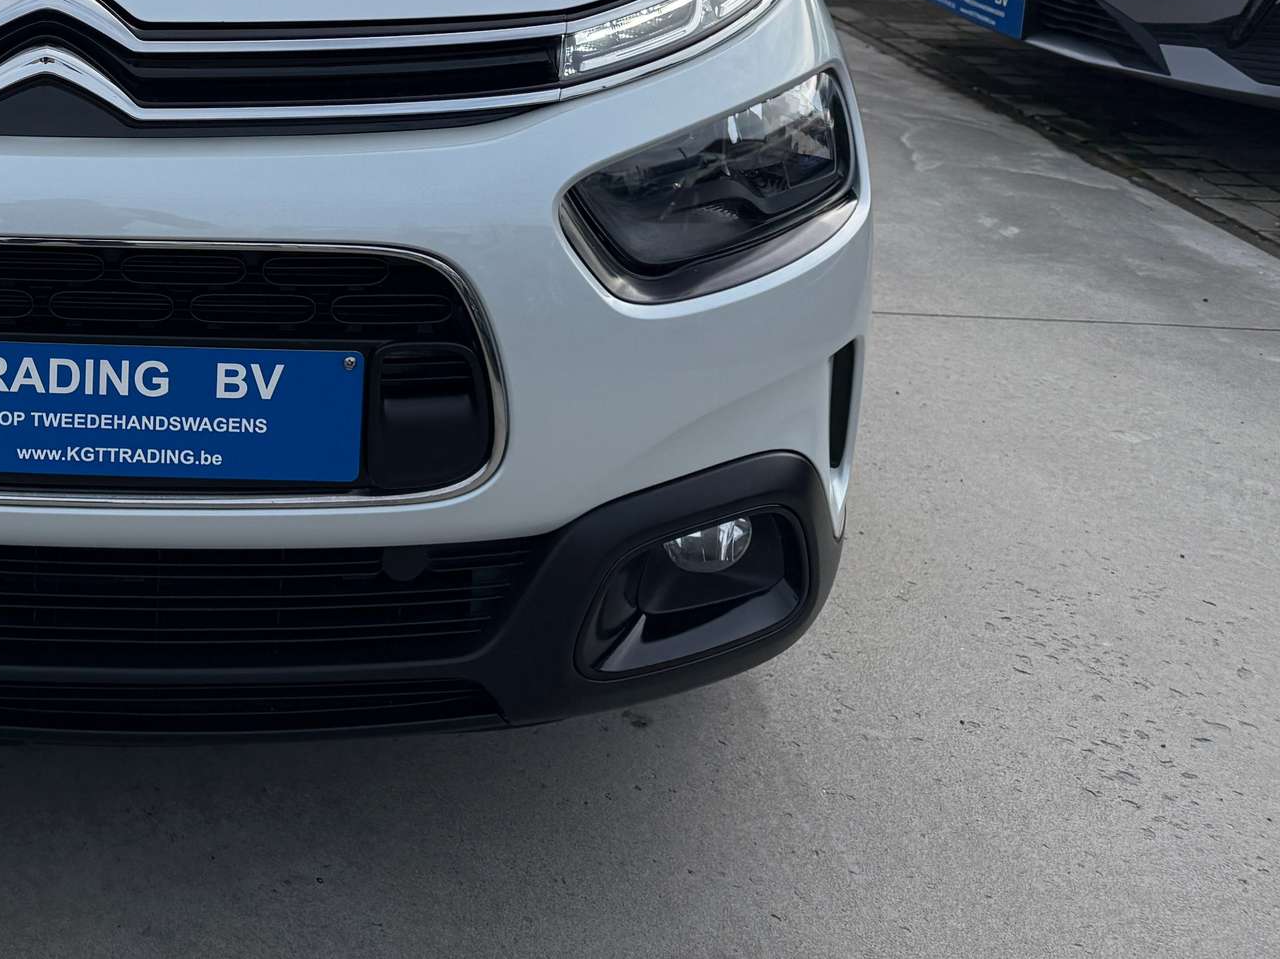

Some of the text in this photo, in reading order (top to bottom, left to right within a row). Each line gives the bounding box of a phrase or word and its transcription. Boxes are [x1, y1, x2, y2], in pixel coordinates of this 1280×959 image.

[215, 362, 285, 400] BV
[30, 412, 268, 434] TWEEDEHANDSWAGENS
[16, 446, 223, 466] www.KGTTRADING.be
